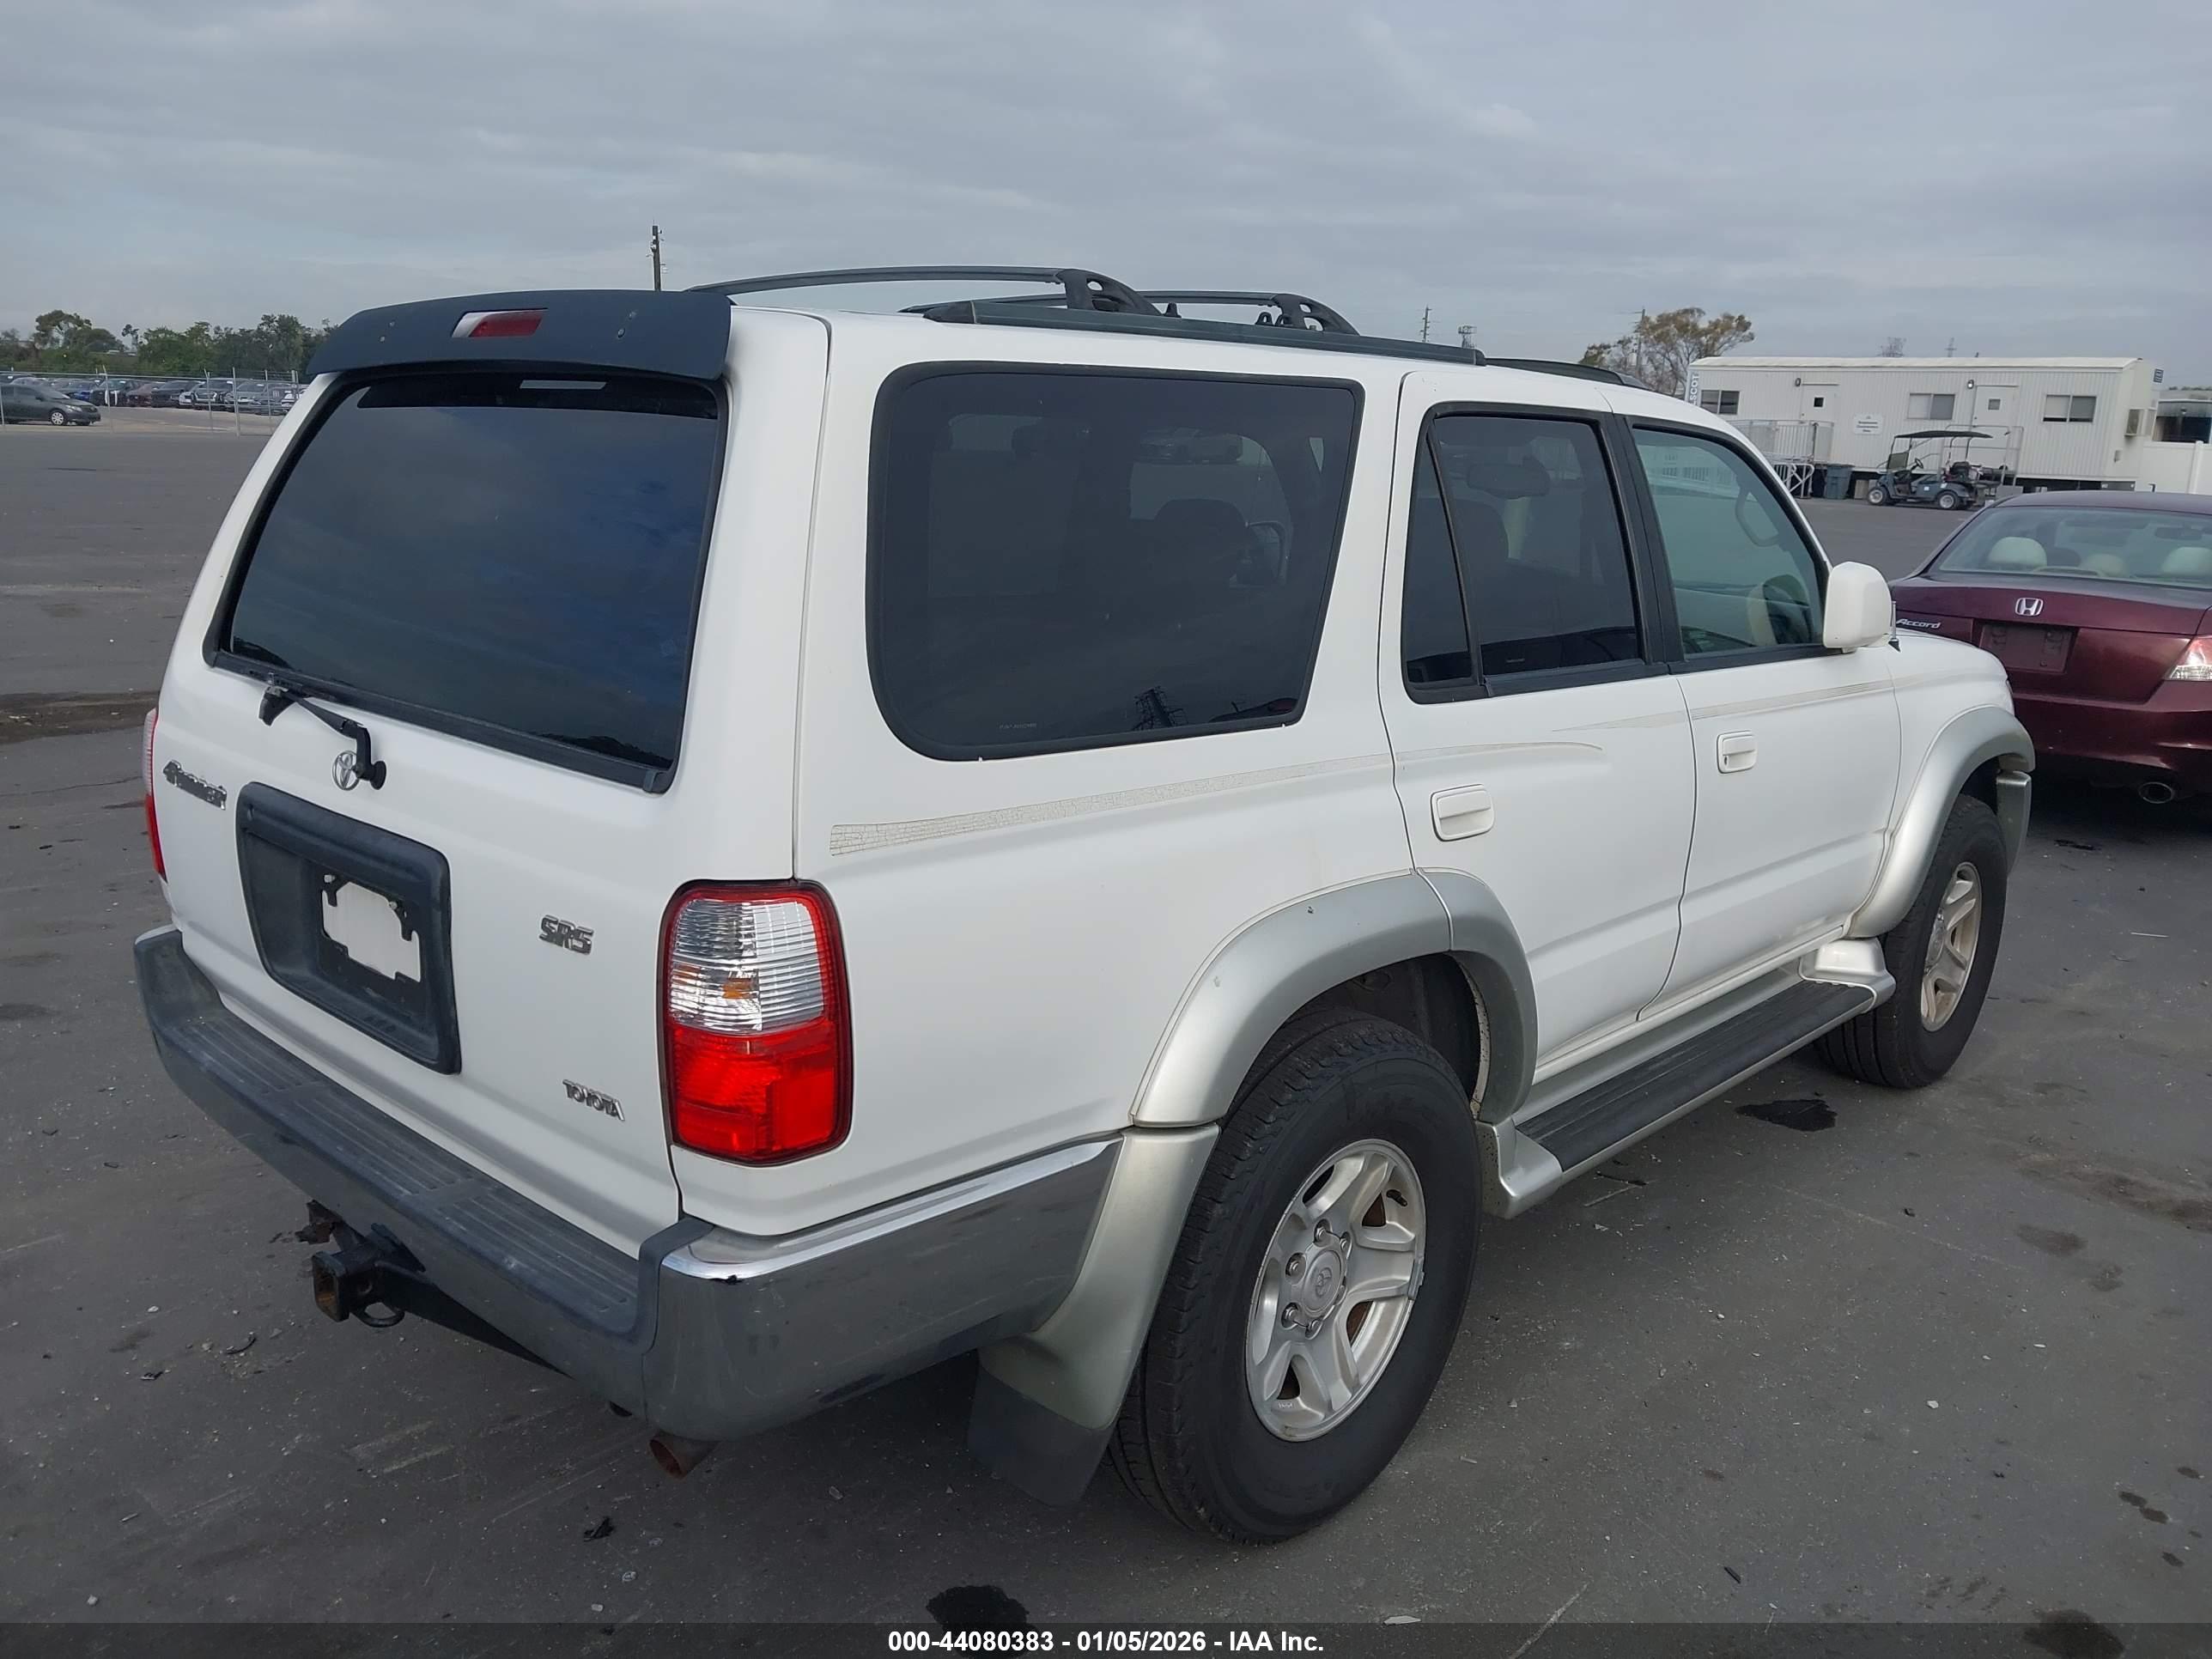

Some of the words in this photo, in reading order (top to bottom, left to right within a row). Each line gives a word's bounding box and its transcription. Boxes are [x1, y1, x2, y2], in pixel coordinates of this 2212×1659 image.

[1896, 618, 1941, 629] Accord
[539, 915, 594, 955] SR5
[562, 1079, 625, 1121] TOYOTA
